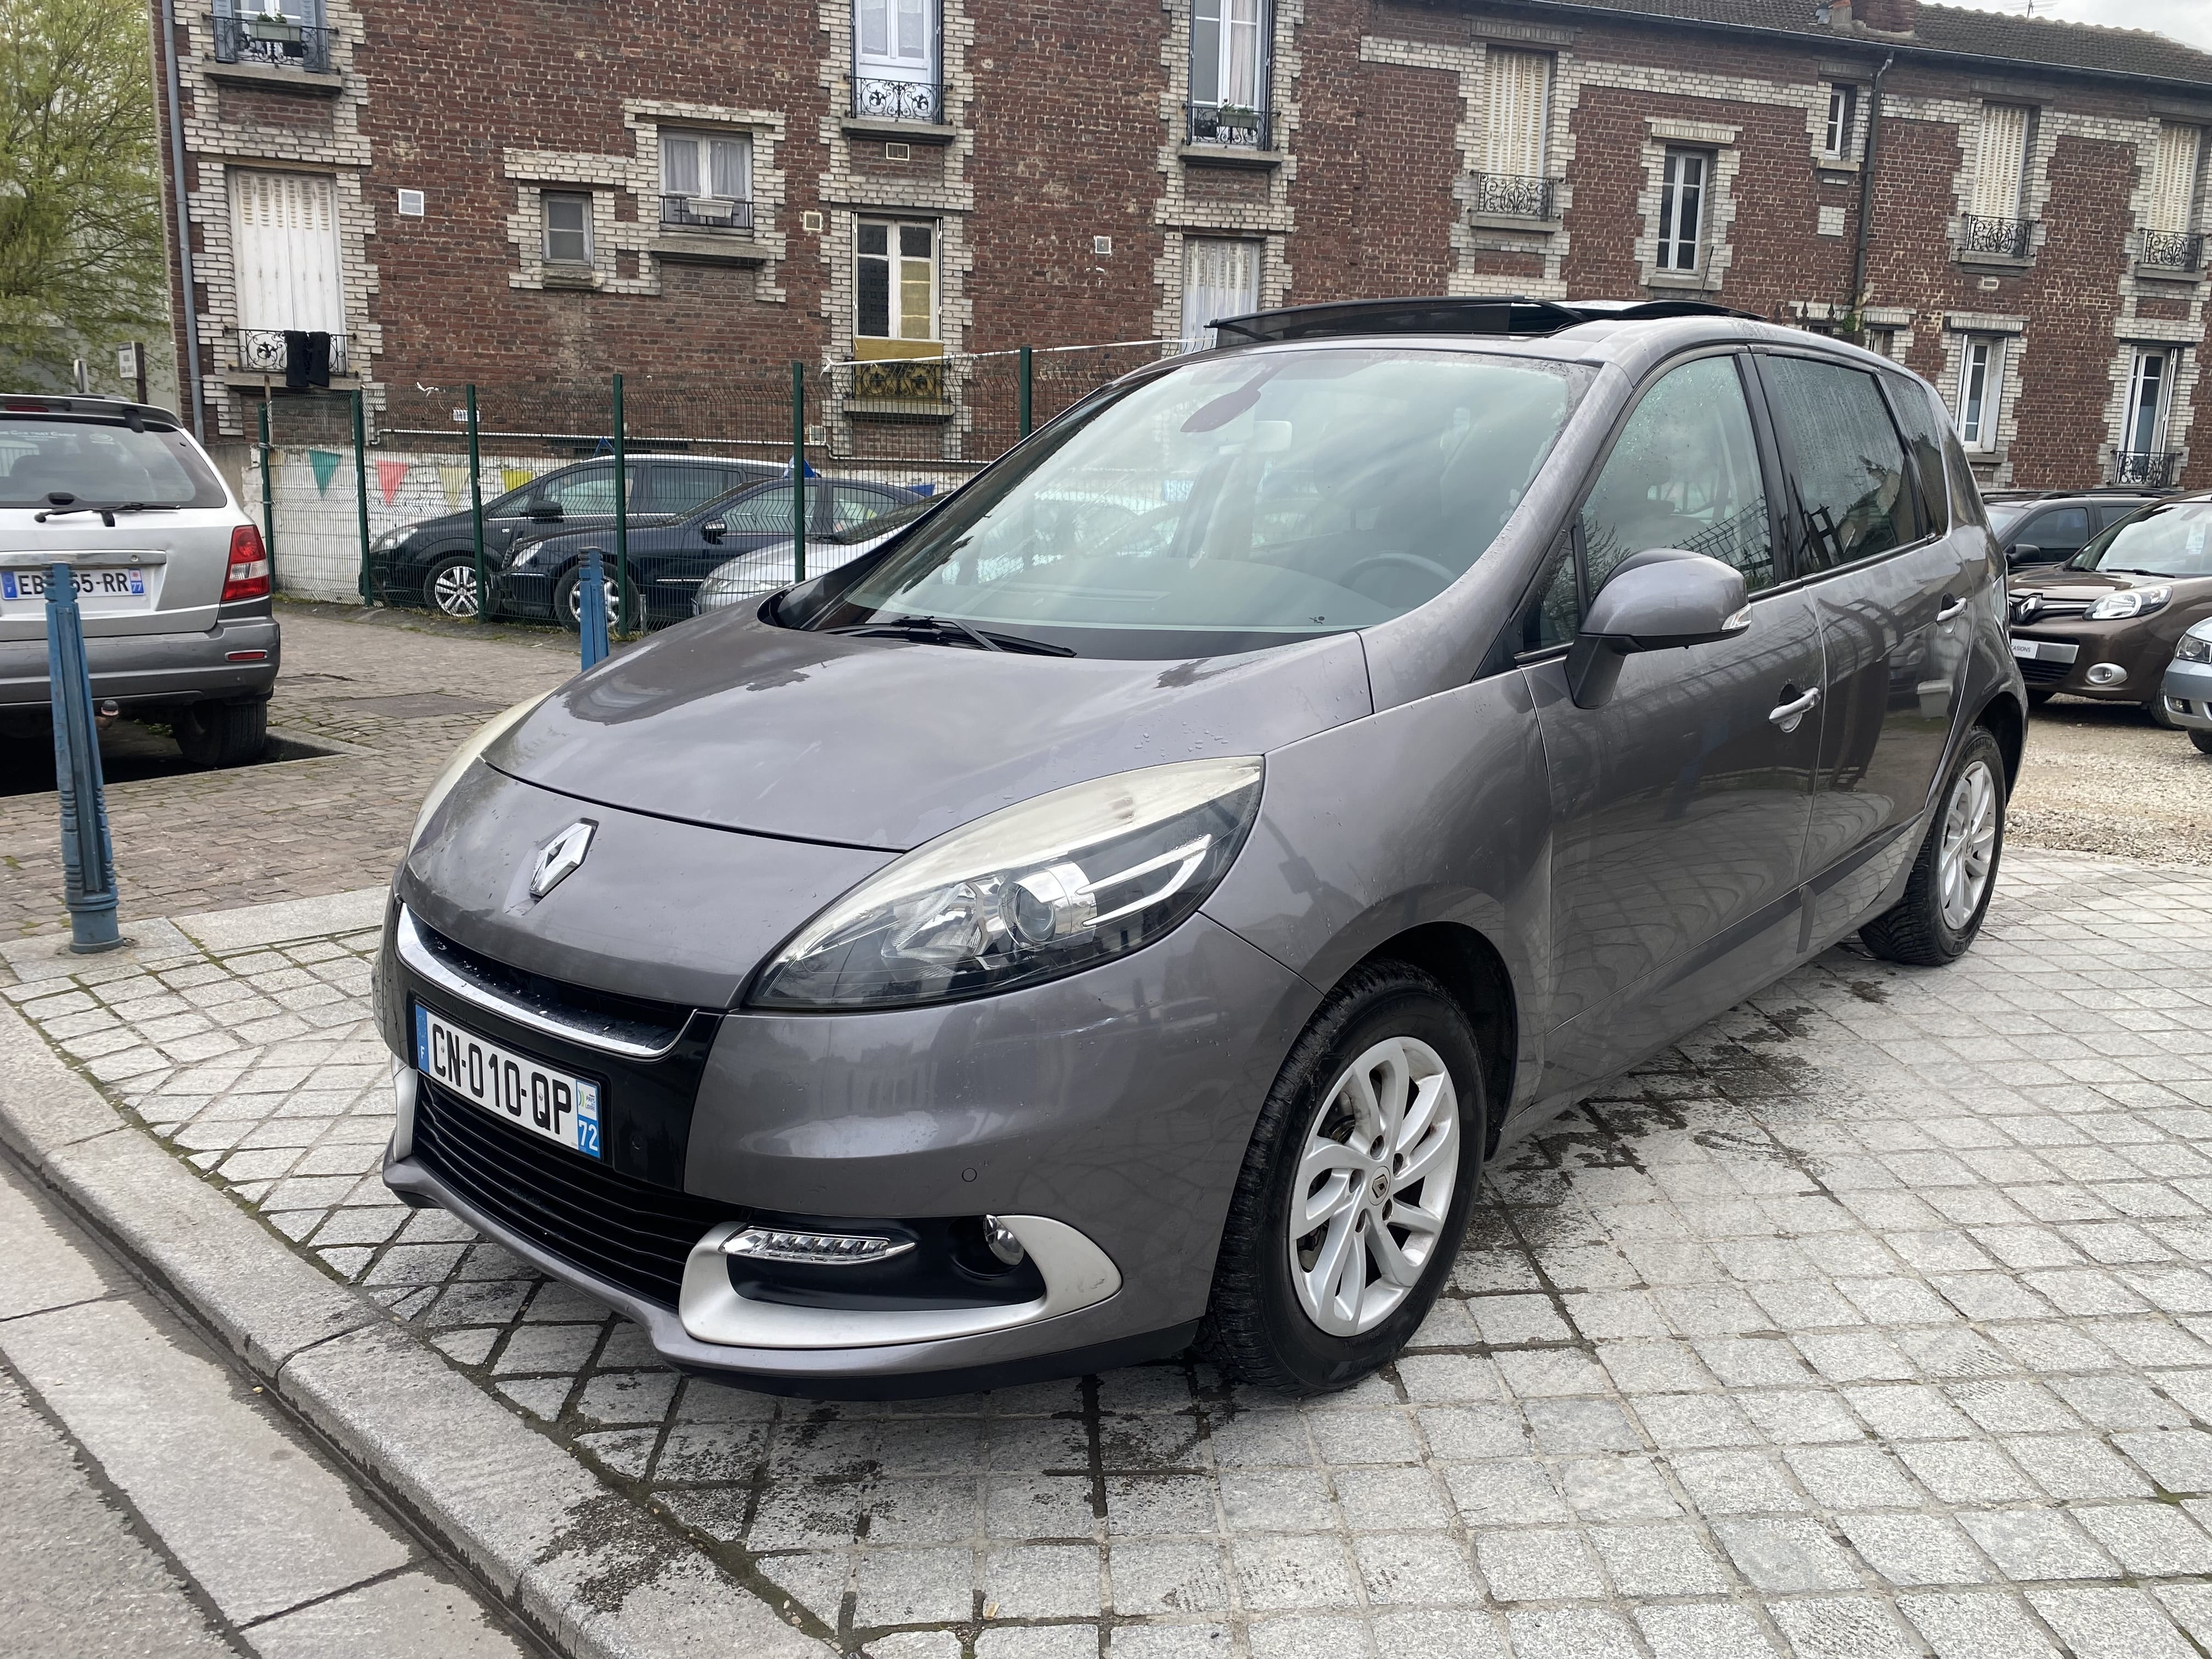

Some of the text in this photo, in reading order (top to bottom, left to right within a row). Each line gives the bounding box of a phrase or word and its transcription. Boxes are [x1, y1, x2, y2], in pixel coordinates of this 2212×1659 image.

[132, 583, 142, 592] 77
[420, 1045, 424, 1060] F
[432, 1023, 571, 1135] CN-010-QP
[578, 1119, 598, 1152] 72
